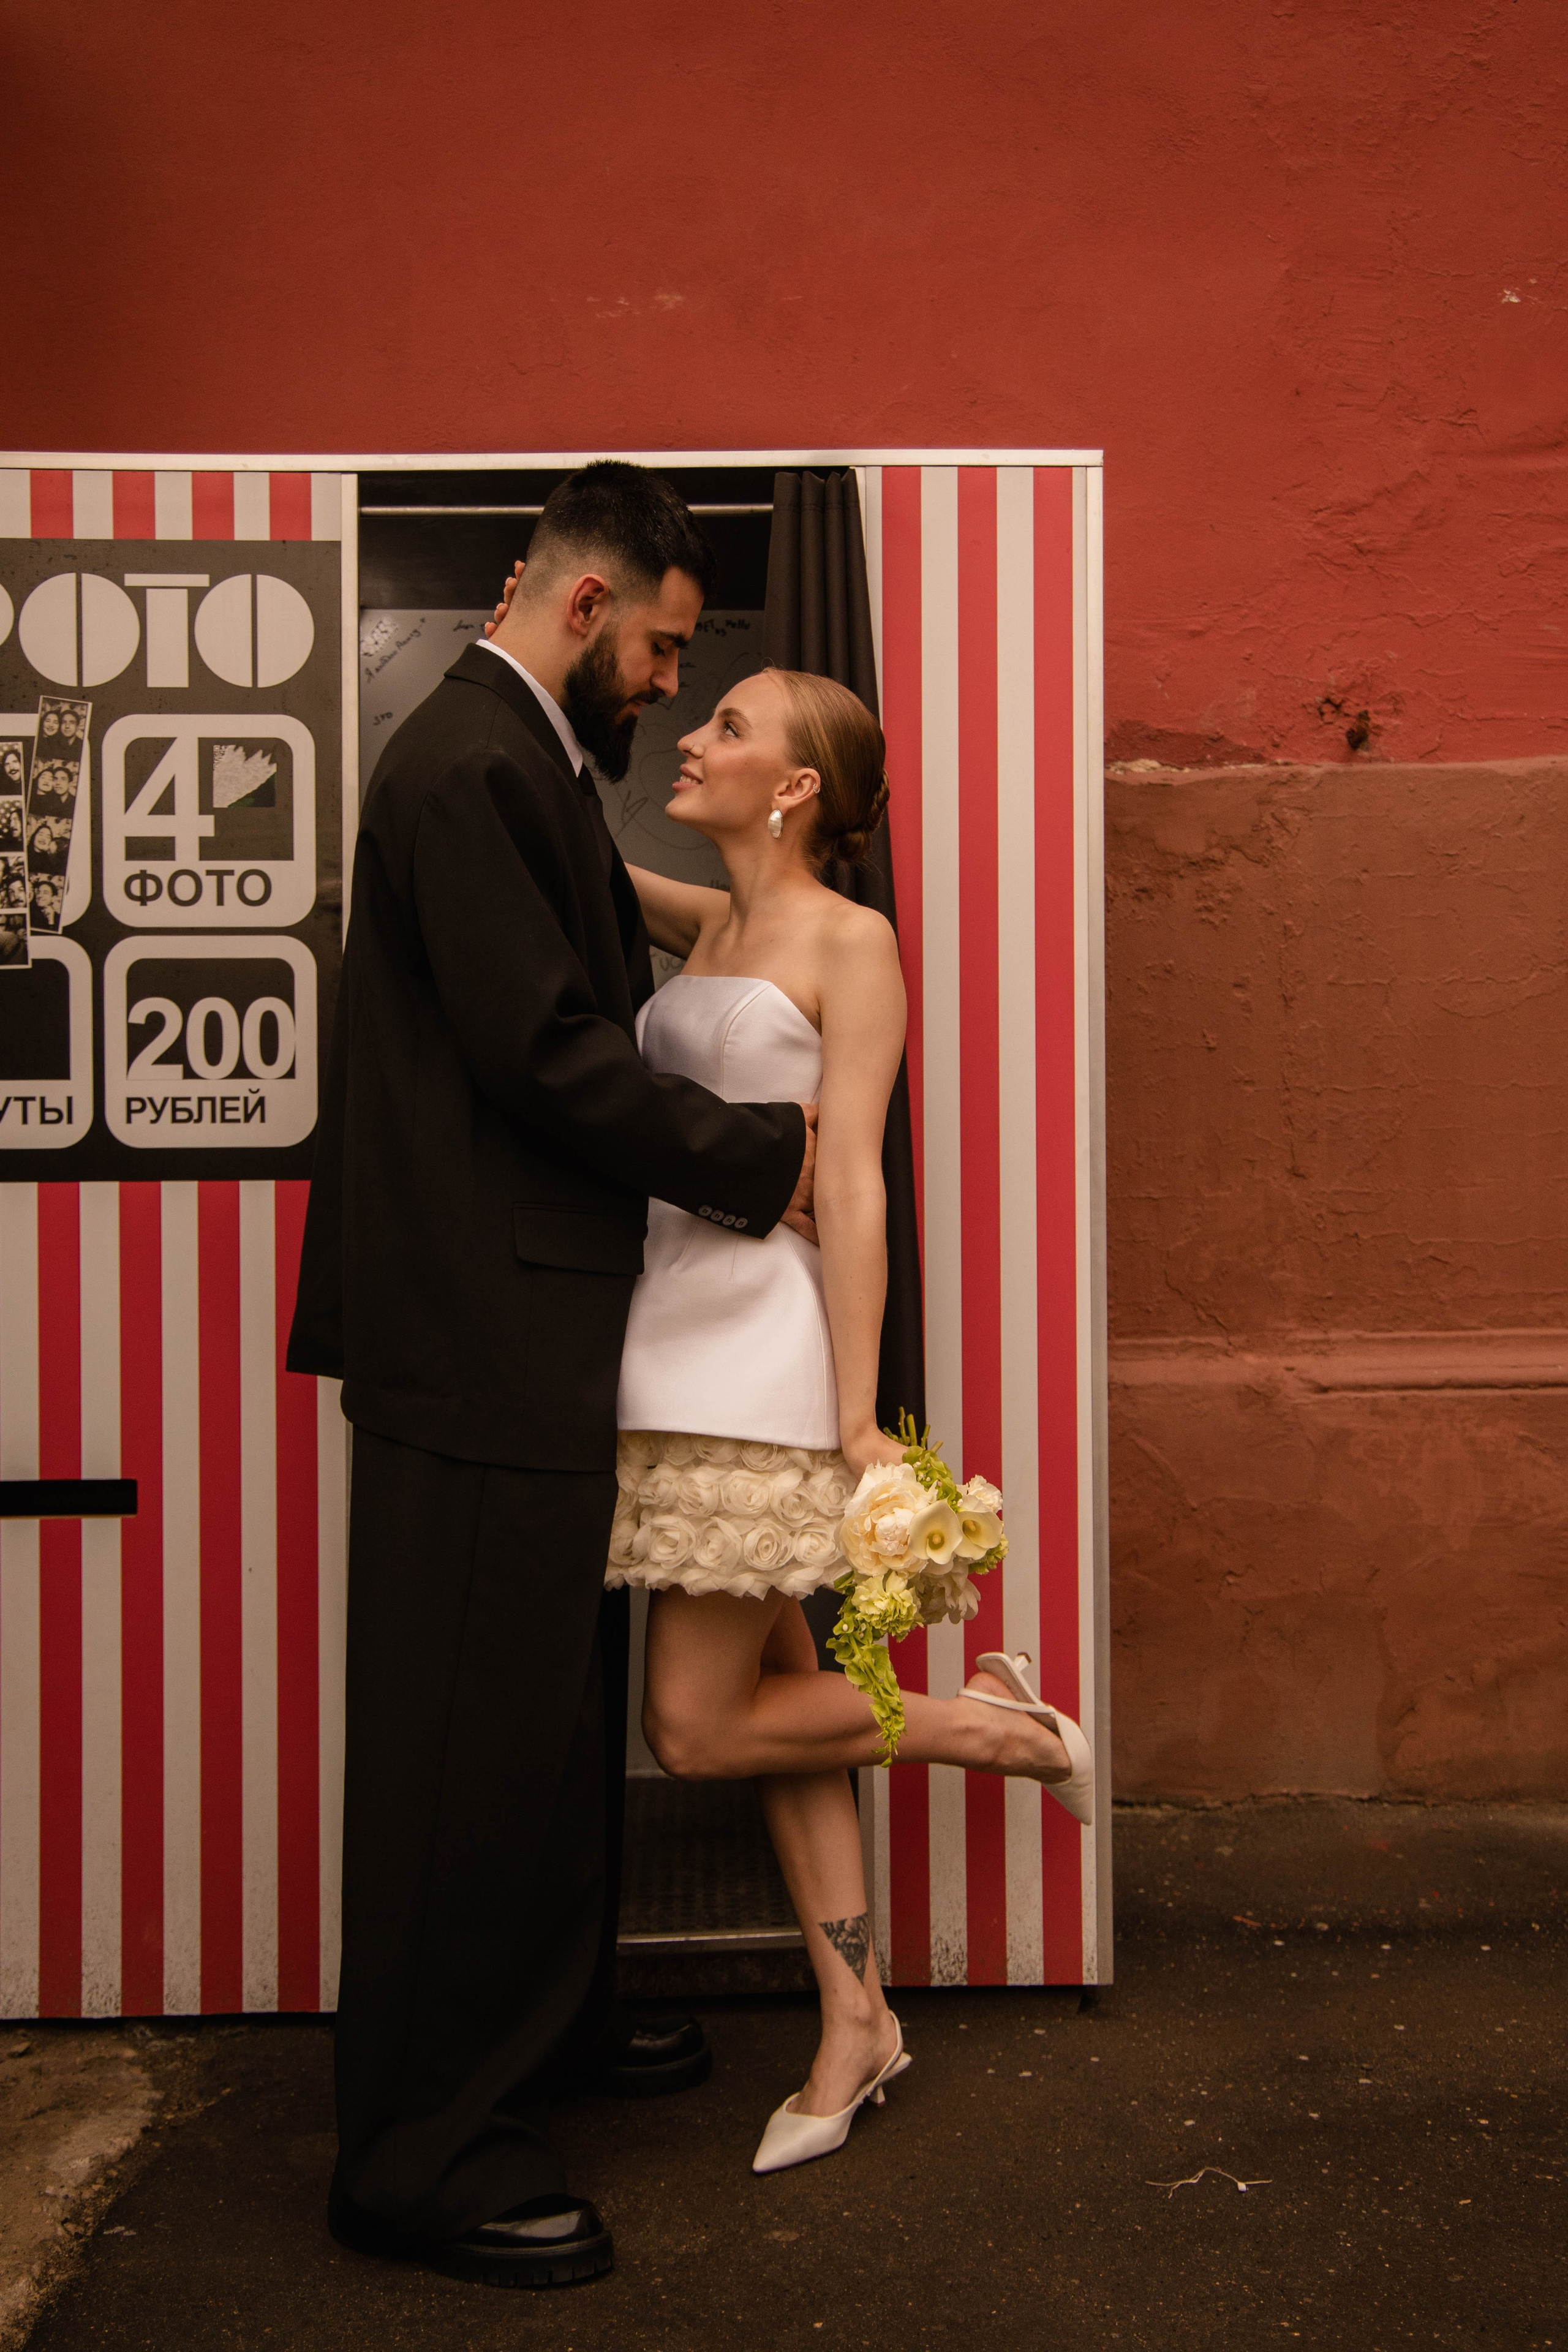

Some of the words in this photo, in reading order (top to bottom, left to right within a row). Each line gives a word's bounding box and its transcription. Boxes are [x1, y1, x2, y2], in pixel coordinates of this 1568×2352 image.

[0, 573, 315, 688] ОТО
[124, 737, 215, 861] 4
[124, 869, 272, 907] ФОТО
[127, 997, 296, 1080] 200
[126, 1088, 266, 1125] РУБЛЕЙ
